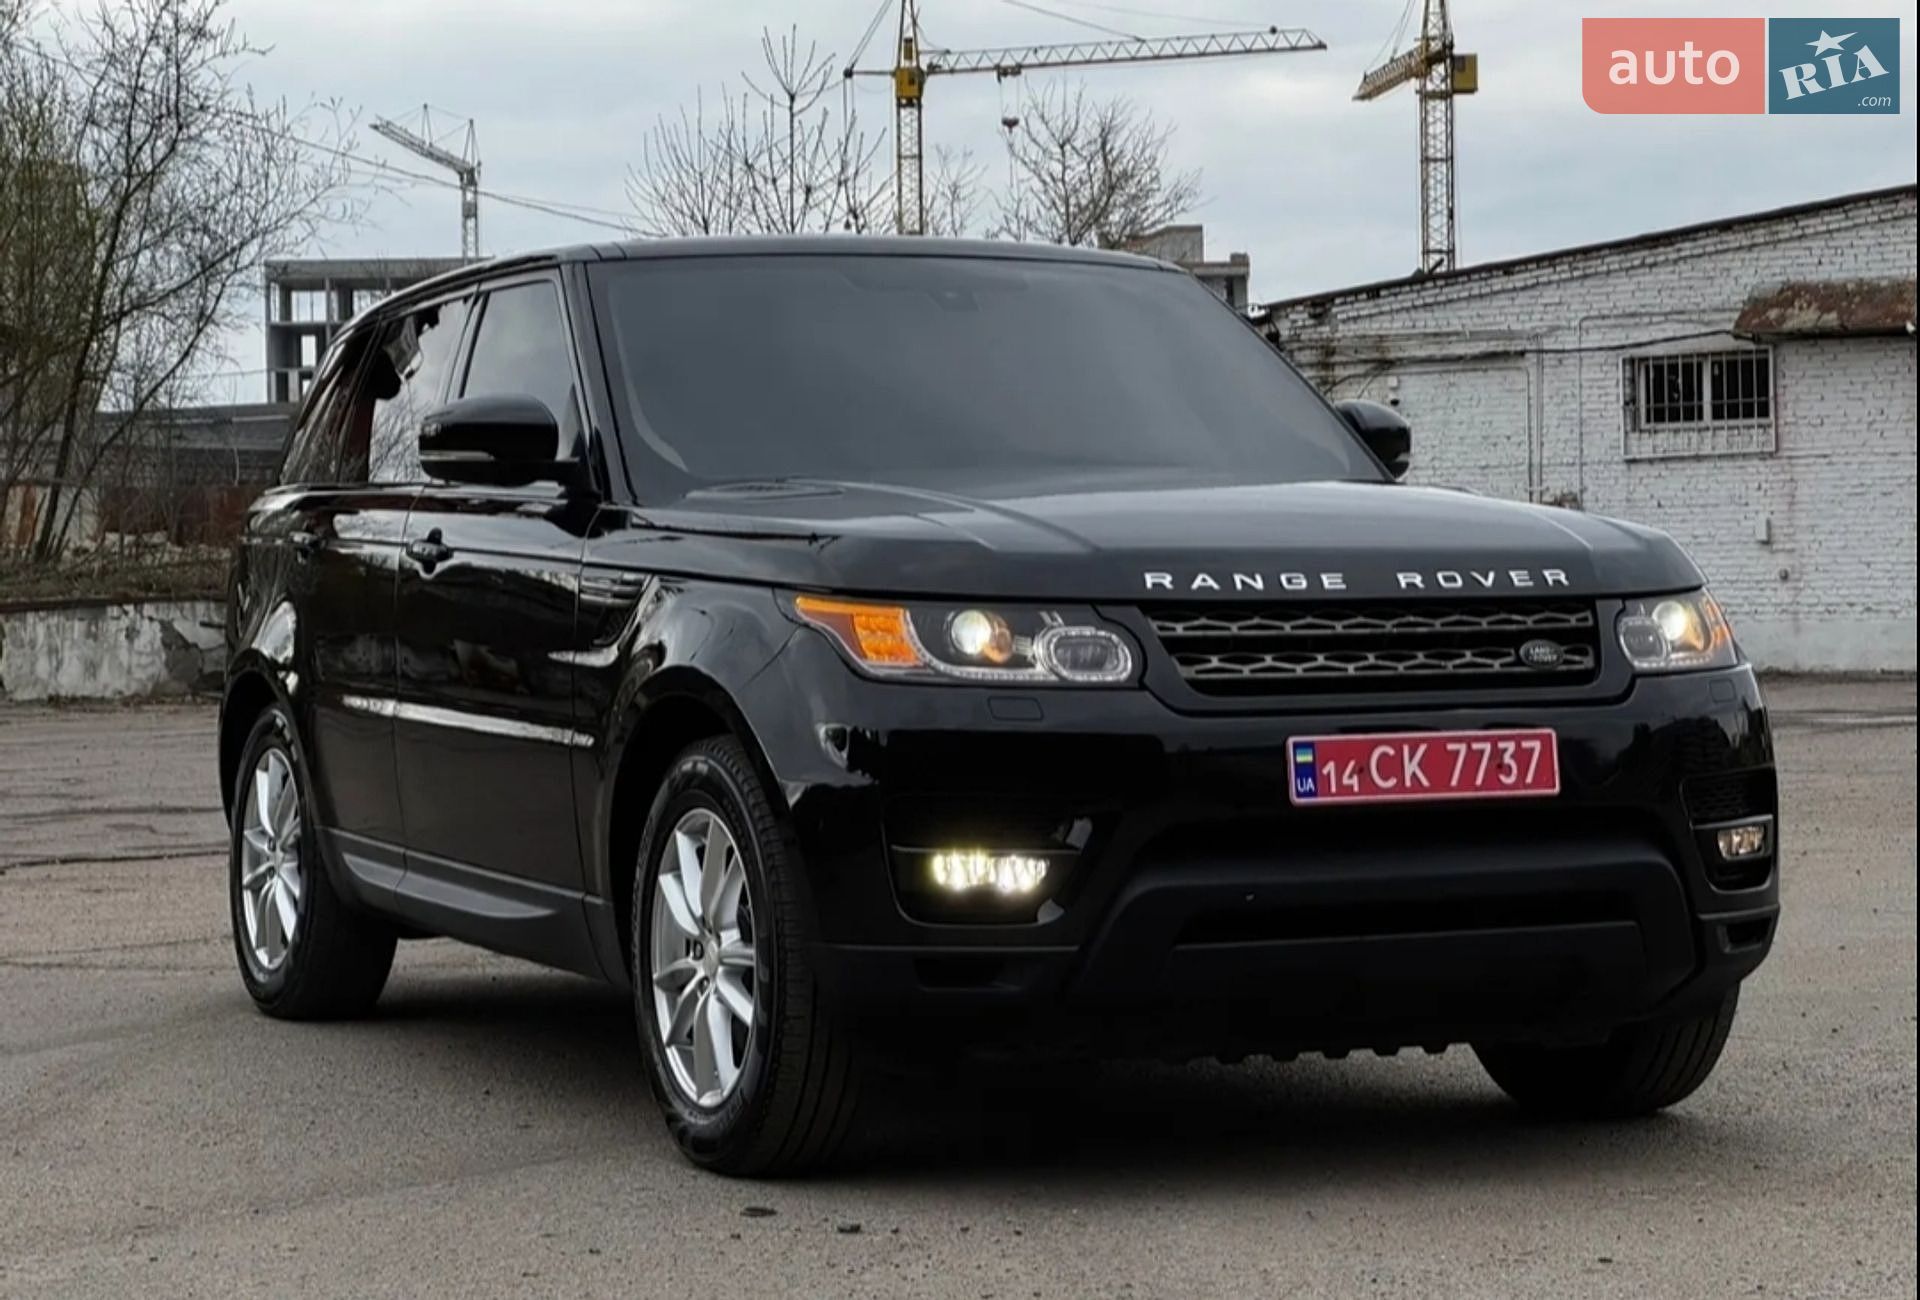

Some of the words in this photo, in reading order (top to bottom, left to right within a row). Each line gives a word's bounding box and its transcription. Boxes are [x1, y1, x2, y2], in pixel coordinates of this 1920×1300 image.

[1143, 571, 1347, 592] RANGE
[1396, 568, 1571, 590] ROVER
[1321, 761, 1360, 793] 14
[1370, 744, 1430, 789] CK
[1446, 740, 1542, 786] 7737
[1296, 778, 1315, 793] UA
